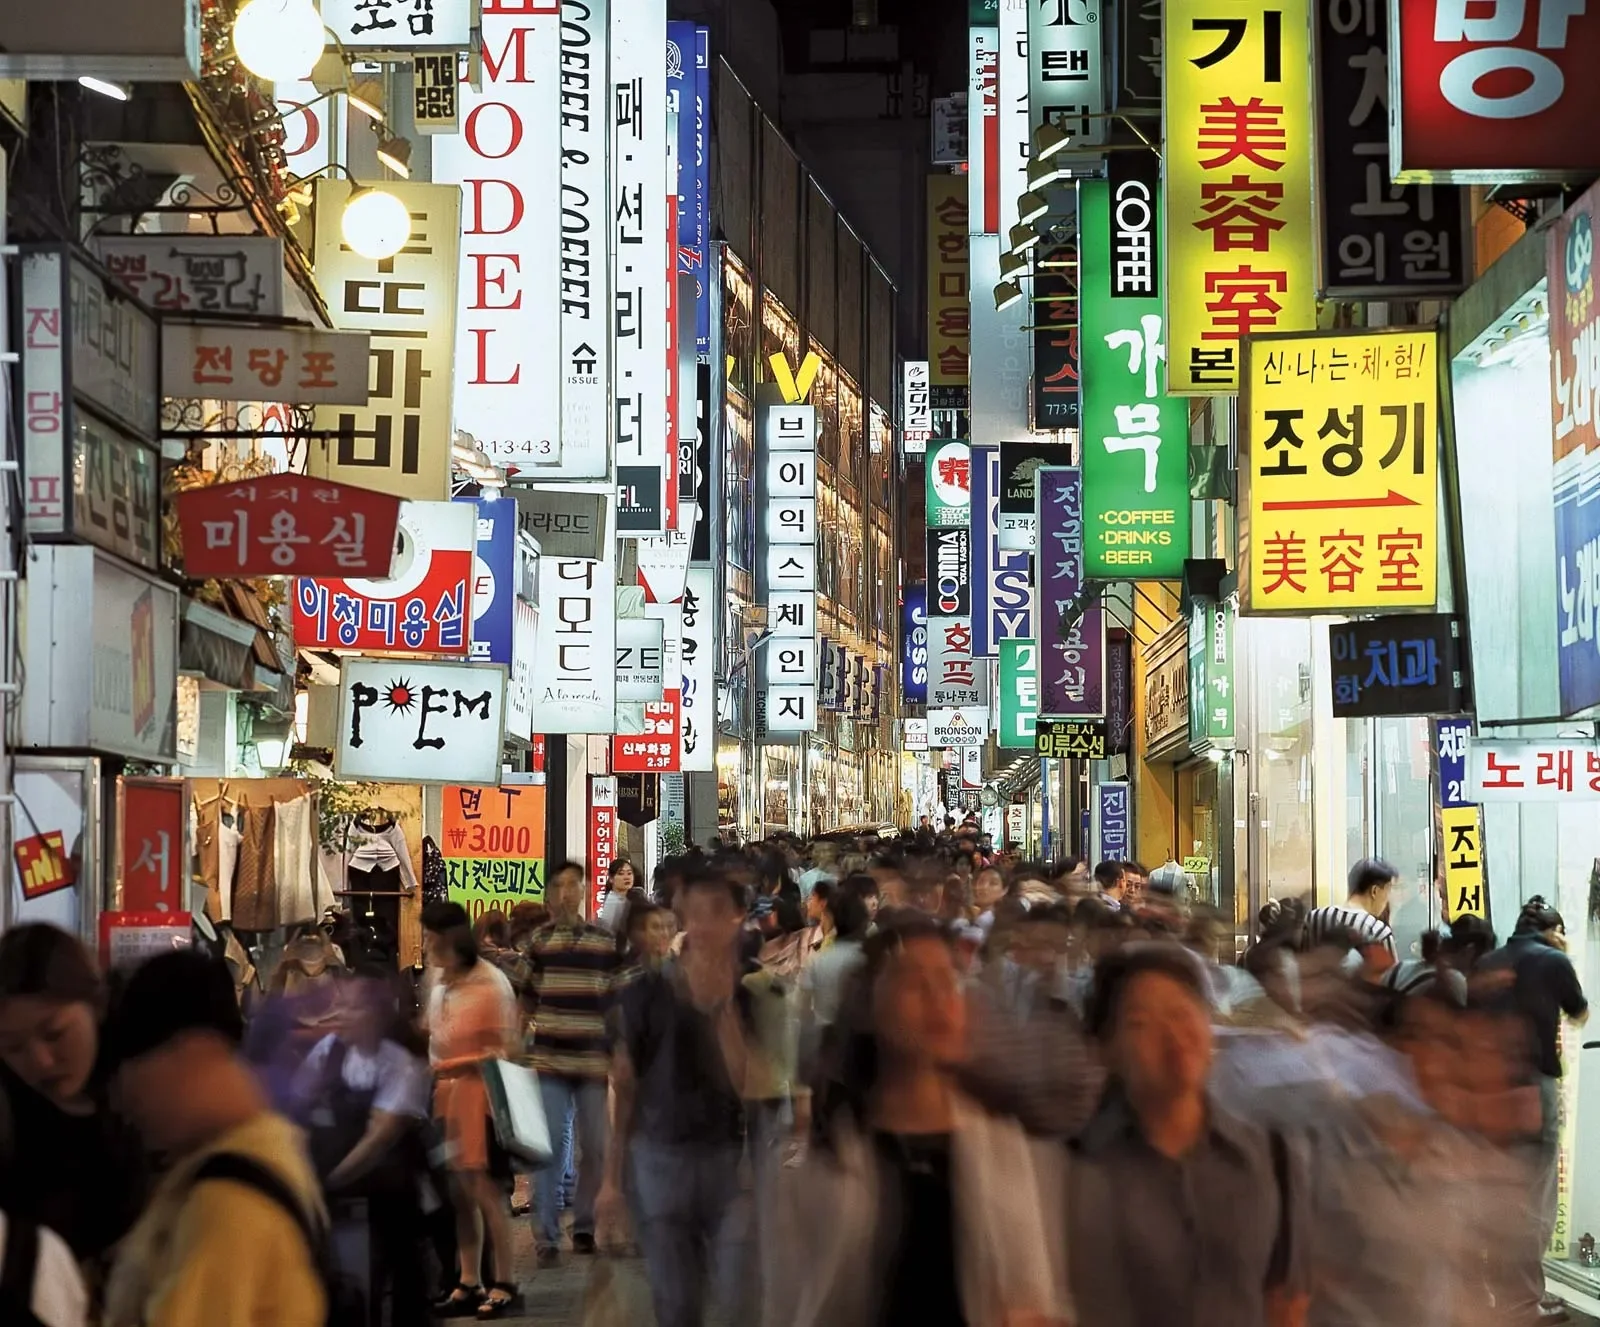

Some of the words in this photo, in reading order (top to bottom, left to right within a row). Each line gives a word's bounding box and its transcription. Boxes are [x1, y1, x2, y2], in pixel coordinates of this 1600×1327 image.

[983, 53, 997, 117] HAIR
[459, 28, 536, 384] MODEL
[1115, 180, 1152, 292] COFFEE
[1338, 229, 1451, 284] 의원
[192, 346, 339, 389] 전당포
[568, 376, 599, 385] ISSUE
[26, 307, 61, 518] 전당포
[907, 381, 928, 429] 보디가드
[1103, 314, 1167, 493] 가무
[1260, 402, 1426, 477] 조성기
[1007, 488, 1036, 499] LAND
[1103, 510, 1175, 525] COFFEE
[202, 509, 368, 568] 미용실
[959, 530, 968, 562] FASHION
[1104, 531, 1172, 545] DRINKS
[1105, 551, 1153, 564] BEER
[1262, 526, 1424, 594] 美容室
[777, 416, 806, 721] 브이익스체인지
[959, 563, 968, 586] TOTAL
[297, 578, 466, 648] 이청미용실
[911, 606, 928, 685] Jess
[939, 622, 976, 687] 호프
[1363, 637, 1440, 687] 치과
[756, 690, 766, 739] EXCHANGE
[1212, 675, 1229, 730] 가무
[934, 726, 982, 736] BRONSON
[1038, 734, 1105, 759] 의류수선
[646, 757, 671, 768] 2.3F
[459, 787, 482, 820] 면
[499, 787, 522, 819] T
